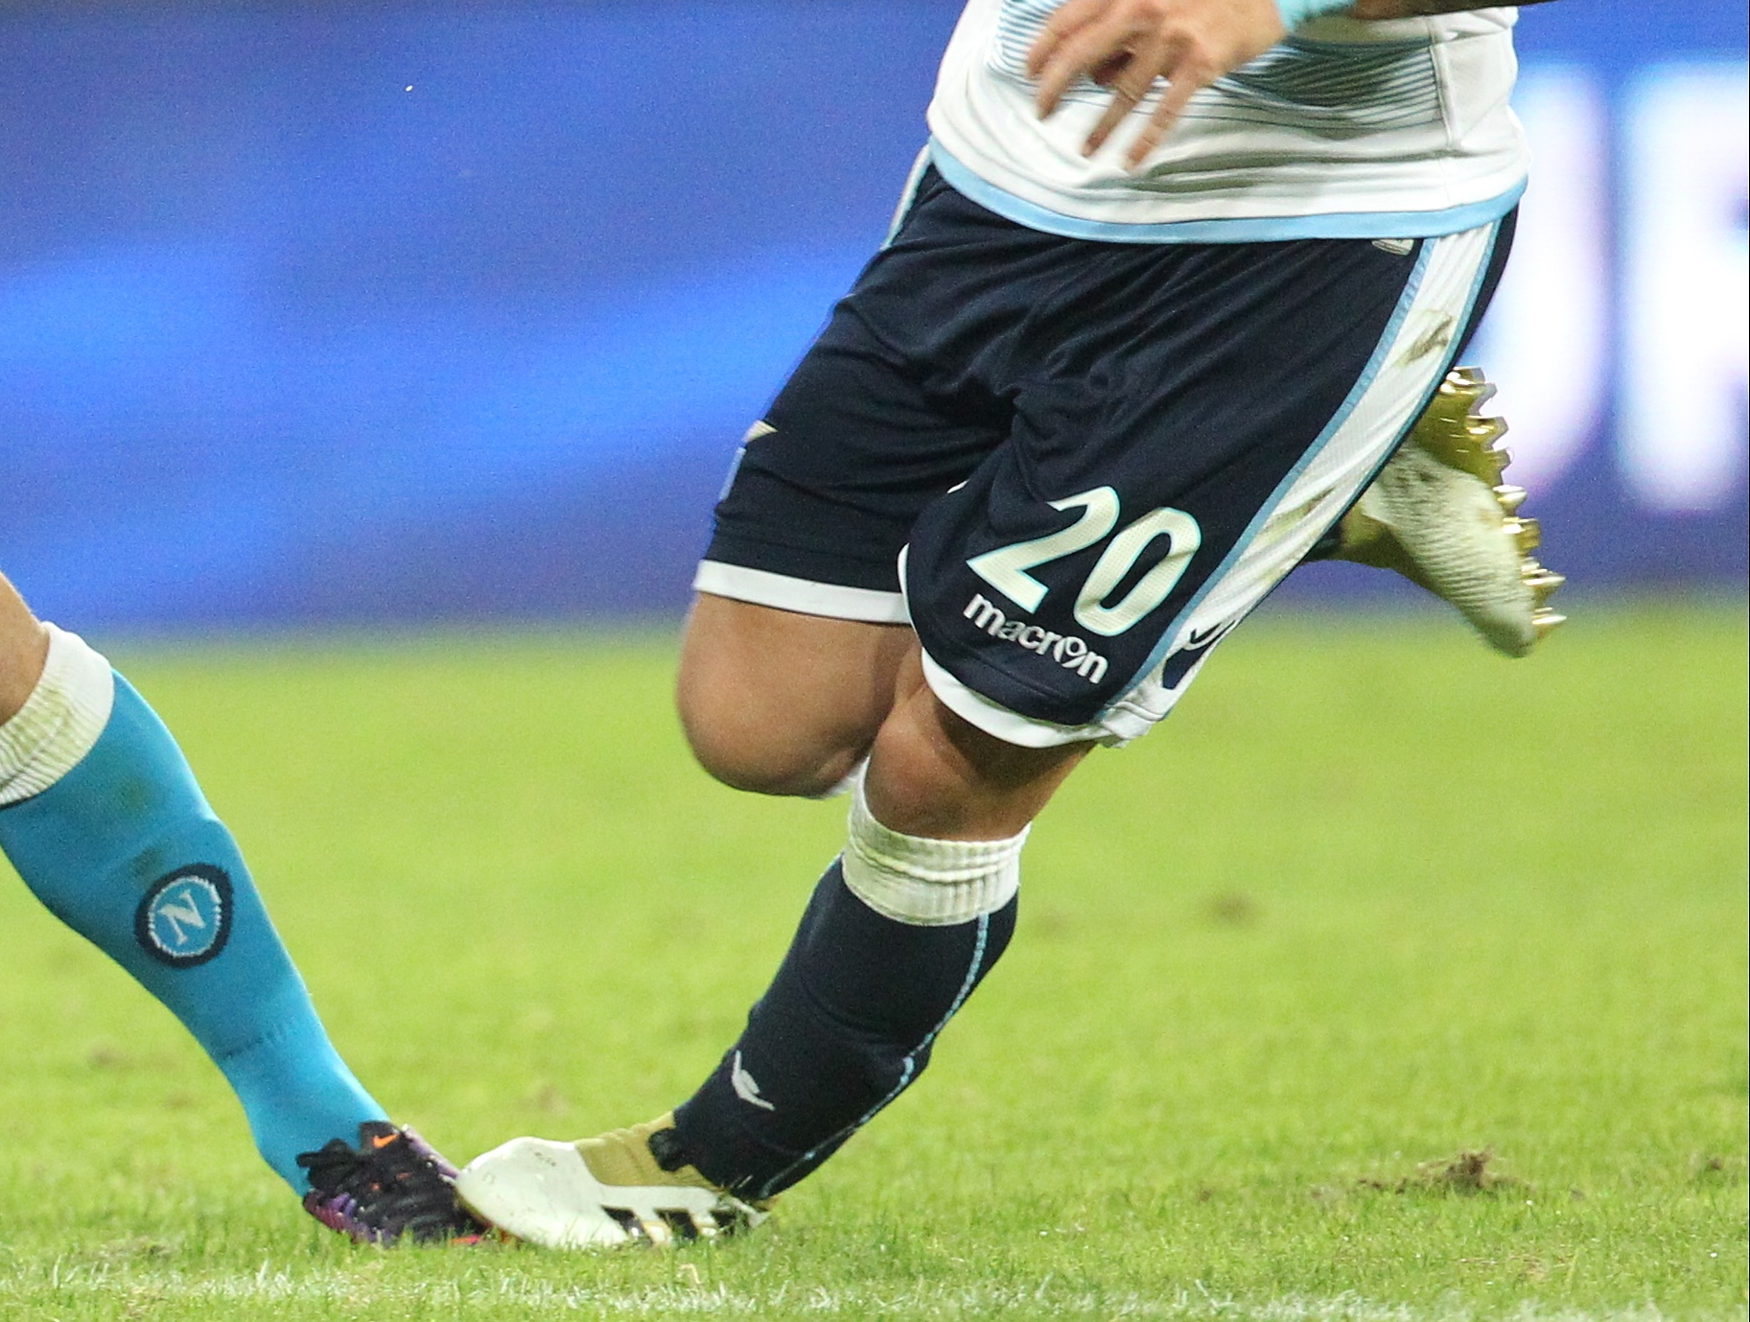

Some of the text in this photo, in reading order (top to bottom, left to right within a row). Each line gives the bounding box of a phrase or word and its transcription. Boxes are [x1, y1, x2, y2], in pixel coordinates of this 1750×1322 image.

[966, 485, 1202, 637] 20
[963, 593, 1109, 684] macron
[158, 889, 206, 946] N
